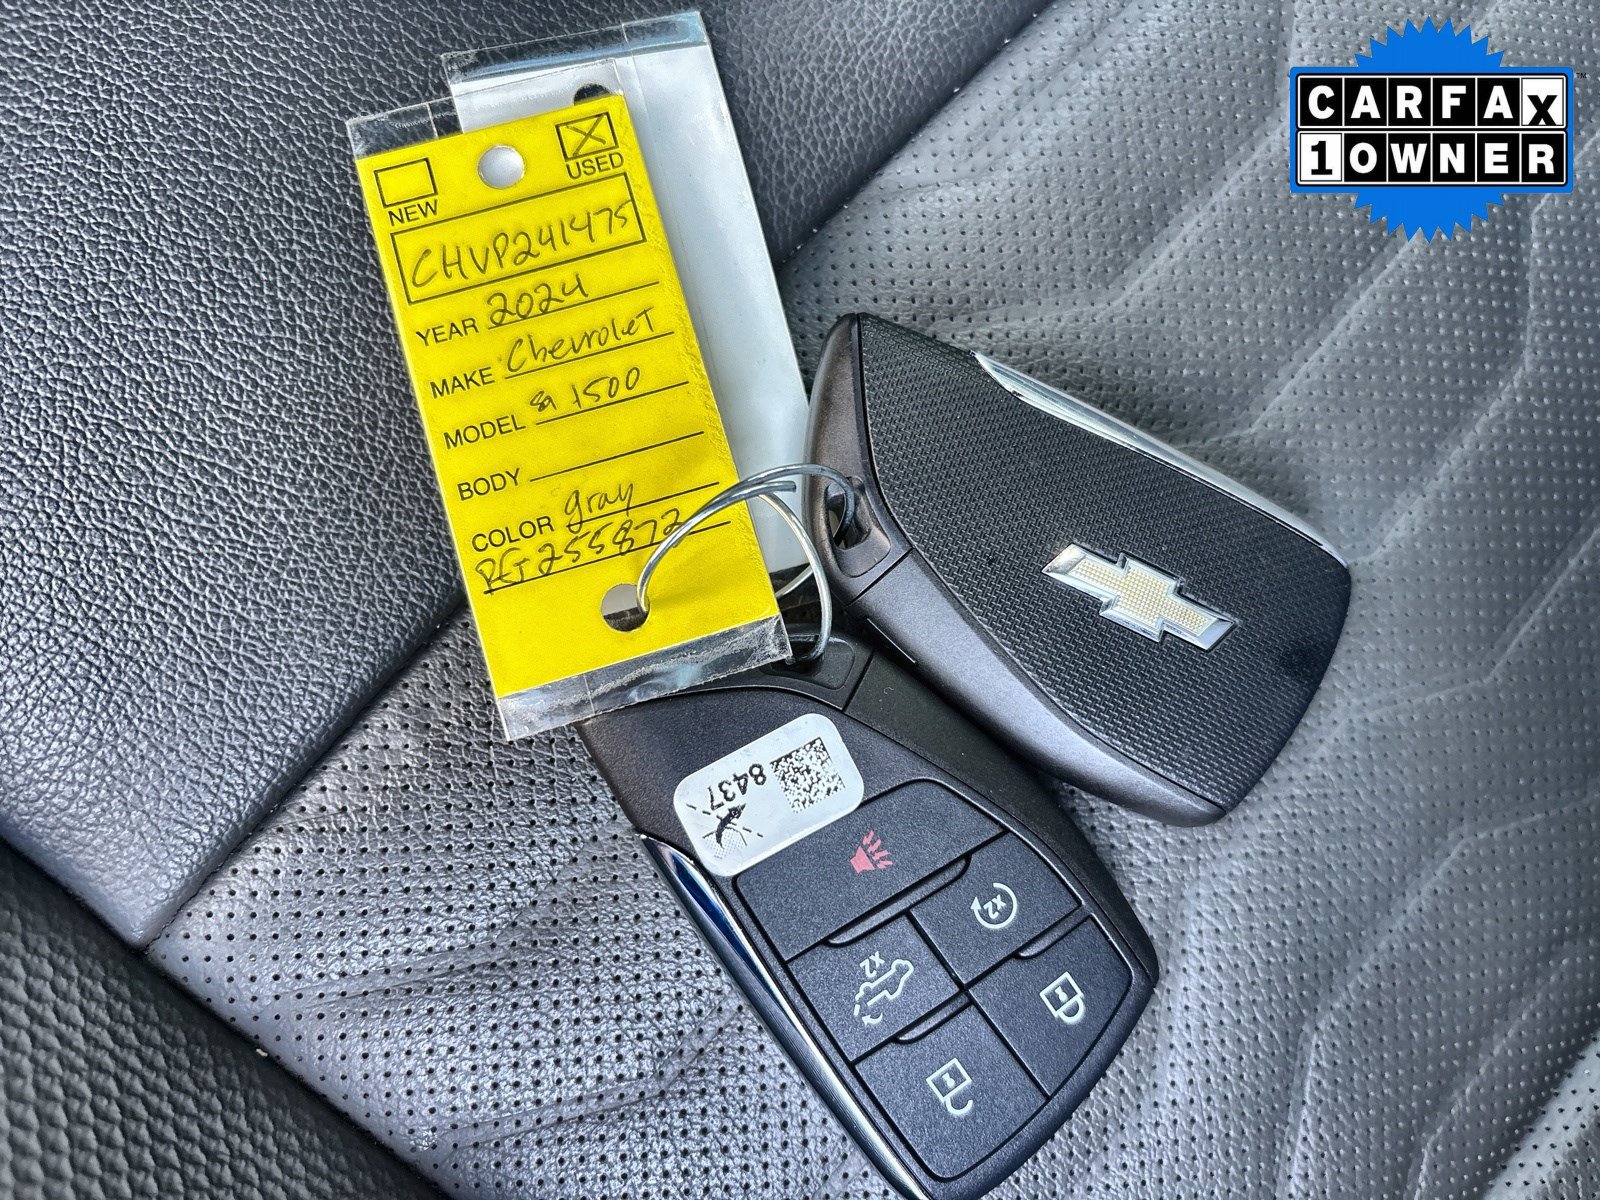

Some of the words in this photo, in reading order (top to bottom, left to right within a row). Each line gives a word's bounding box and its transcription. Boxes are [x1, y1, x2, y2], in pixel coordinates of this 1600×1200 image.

[565, 151, 625, 180] USED
[388, 199, 439, 227] NEW
[416, 317, 479, 348] YEAR
[486, 273, 590, 328] 2024
[430, 366, 496, 399] MAKE
[443, 414, 526, 450] MODEL
[571, 366, 641, 410] 1500
[457, 467, 522, 501] BODY
[470, 515, 555, 552] COLOR
[564, 483, 634, 534] gray
[706, 763, 767, 811] 8437
